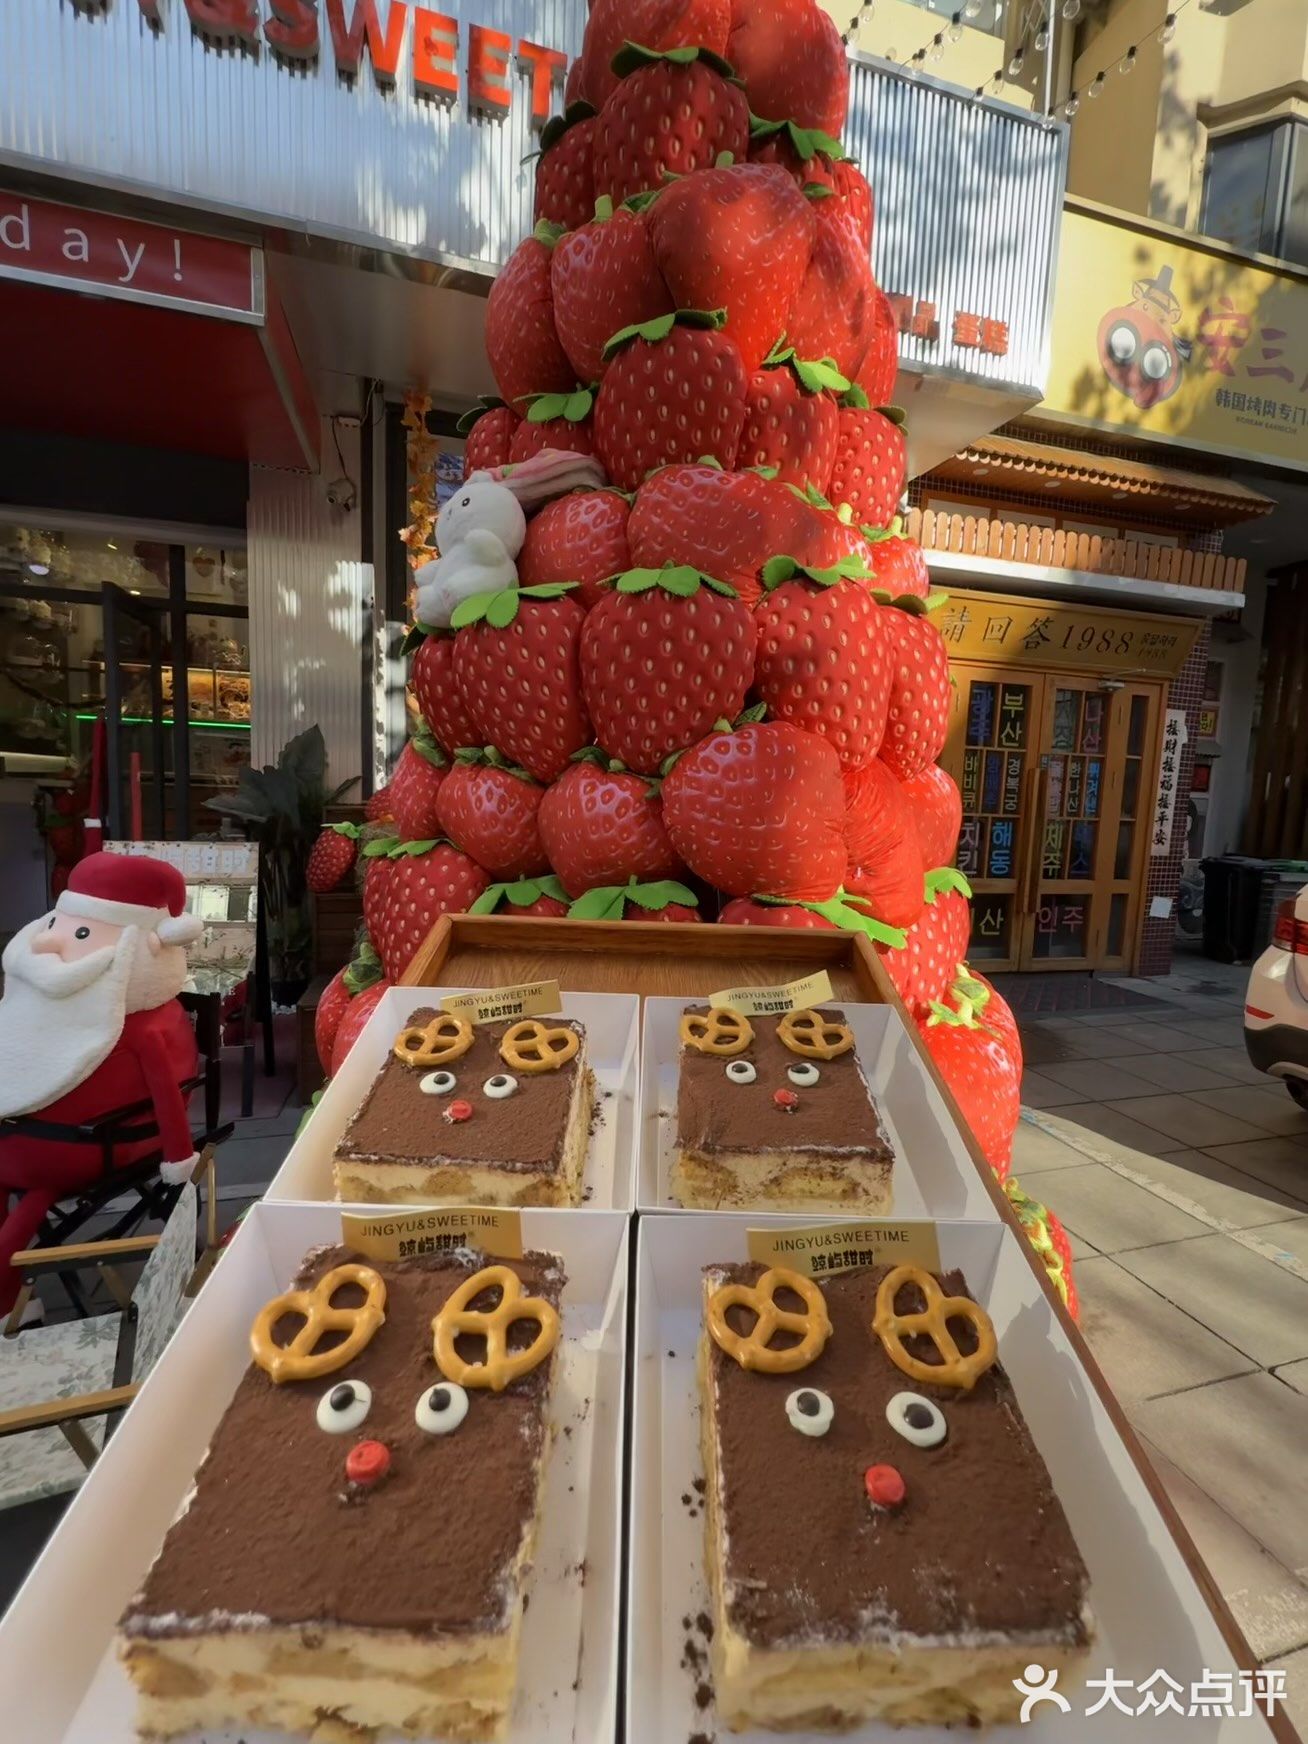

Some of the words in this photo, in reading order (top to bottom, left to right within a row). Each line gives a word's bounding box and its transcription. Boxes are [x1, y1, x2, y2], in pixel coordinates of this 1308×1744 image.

[0, 204, 183, 282] day!
[1197, 297, 1308, 393] 安三
[1216, 388, 1308, 426] 韩国烤肉专门
[1001, 692, 1024, 746] 부산
[958, 822, 980, 875] 치킨
[990, 821, 1013, 875] 해동
[1042, 823, 1063, 876] 제주
[360, 1214, 500, 1237] JINGYU&SWEETIME
[773, 1229, 910, 1252] JINGYU&SWEETIME
